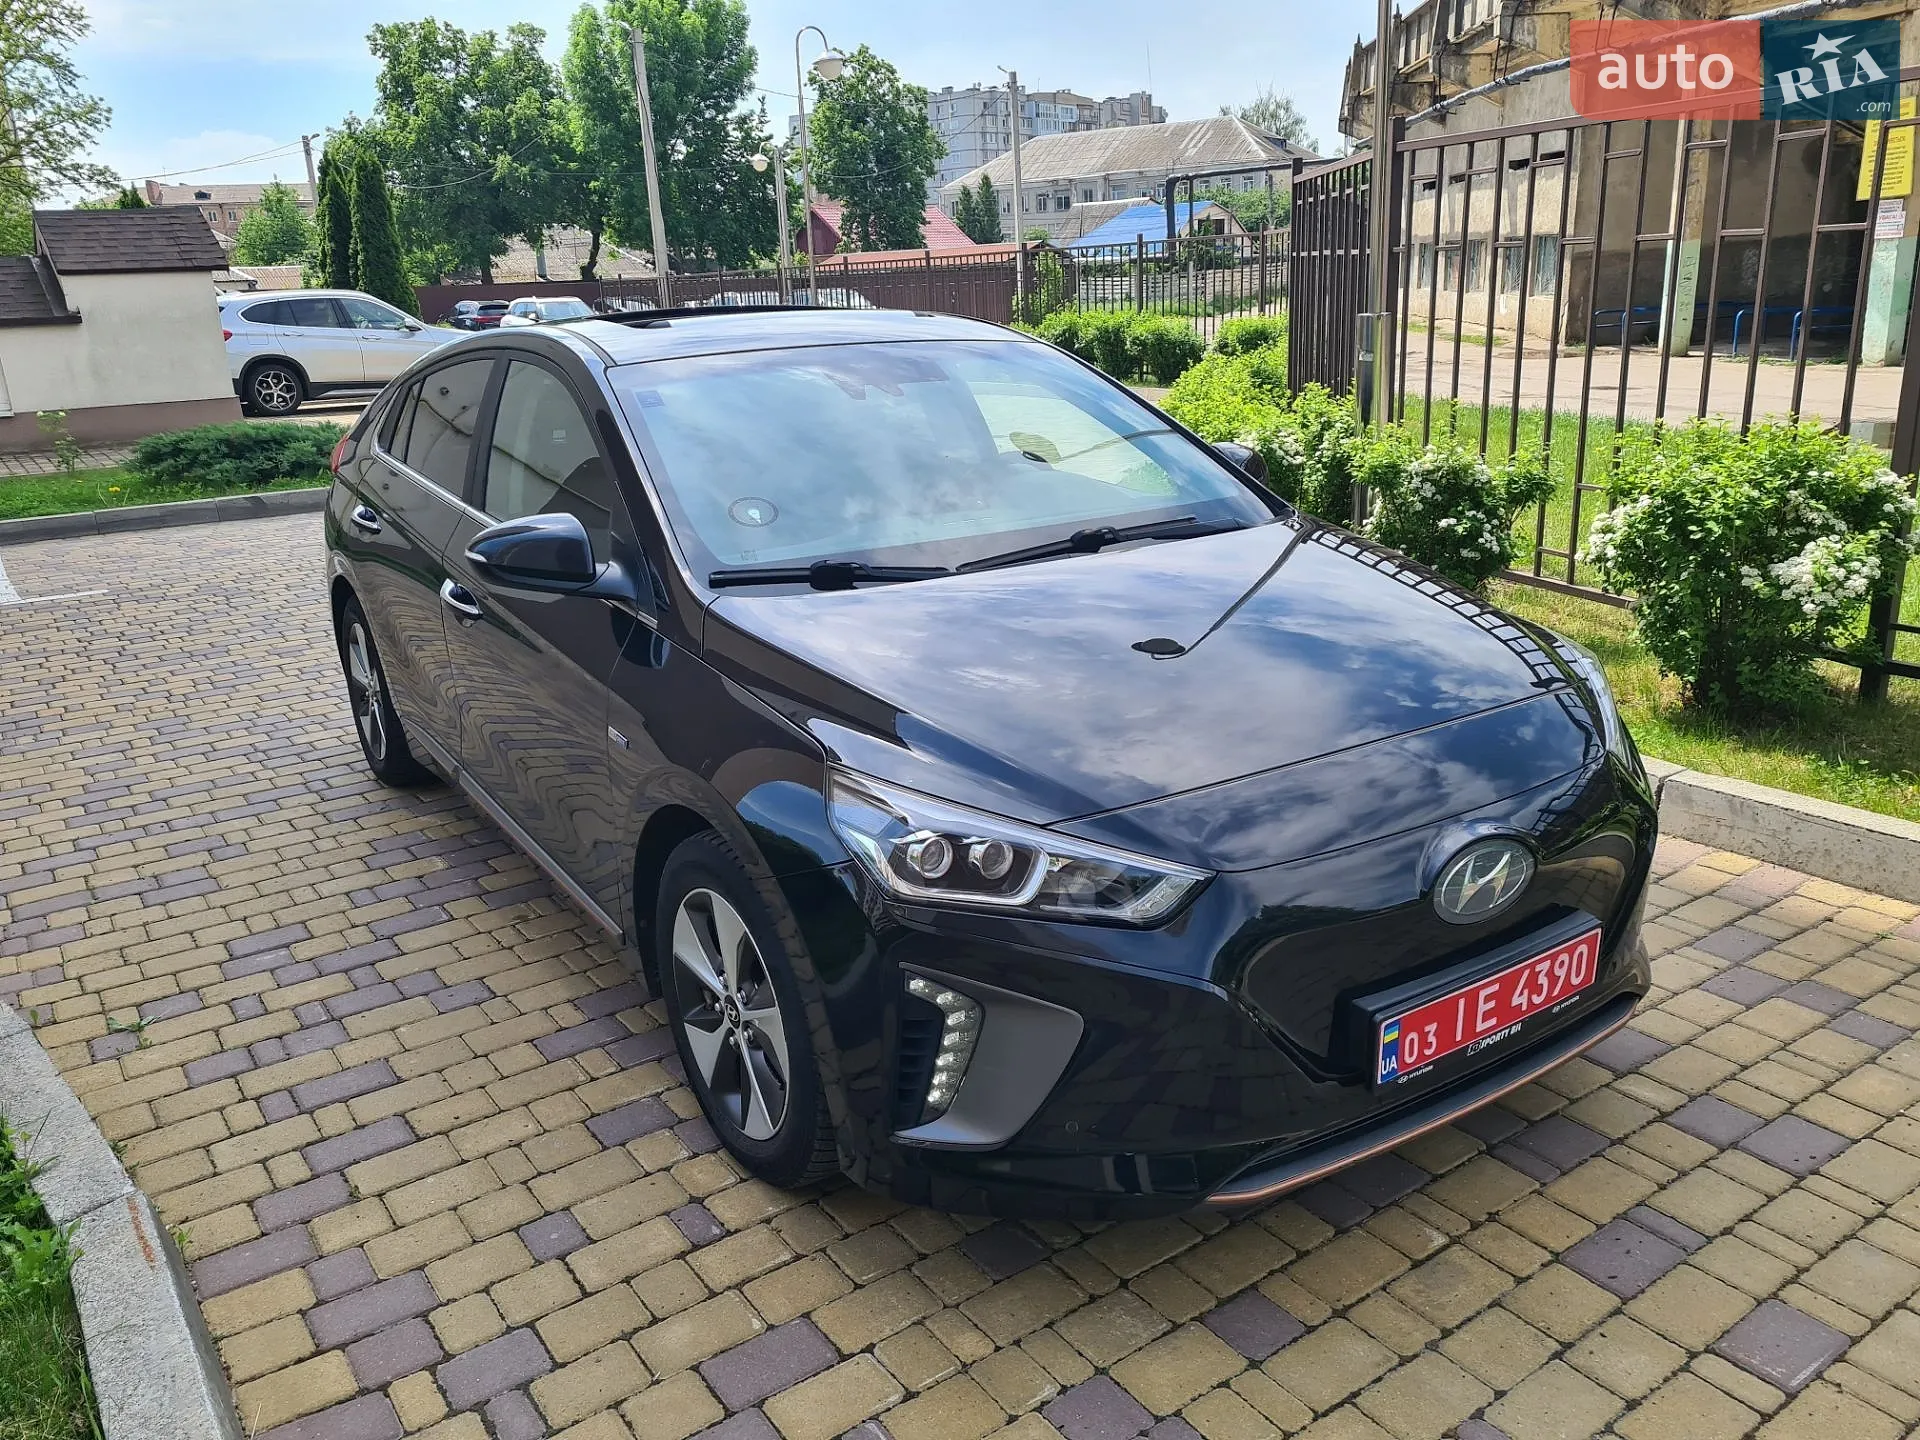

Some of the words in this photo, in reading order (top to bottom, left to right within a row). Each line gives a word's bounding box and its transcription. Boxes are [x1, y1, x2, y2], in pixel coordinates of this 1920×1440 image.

[1404, 1022, 1438, 1064] 03
[1456, 982, 1499, 1041] IE
[1511, 943, 1588, 1011] 4390
[1381, 1055, 1398, 1075] UA
